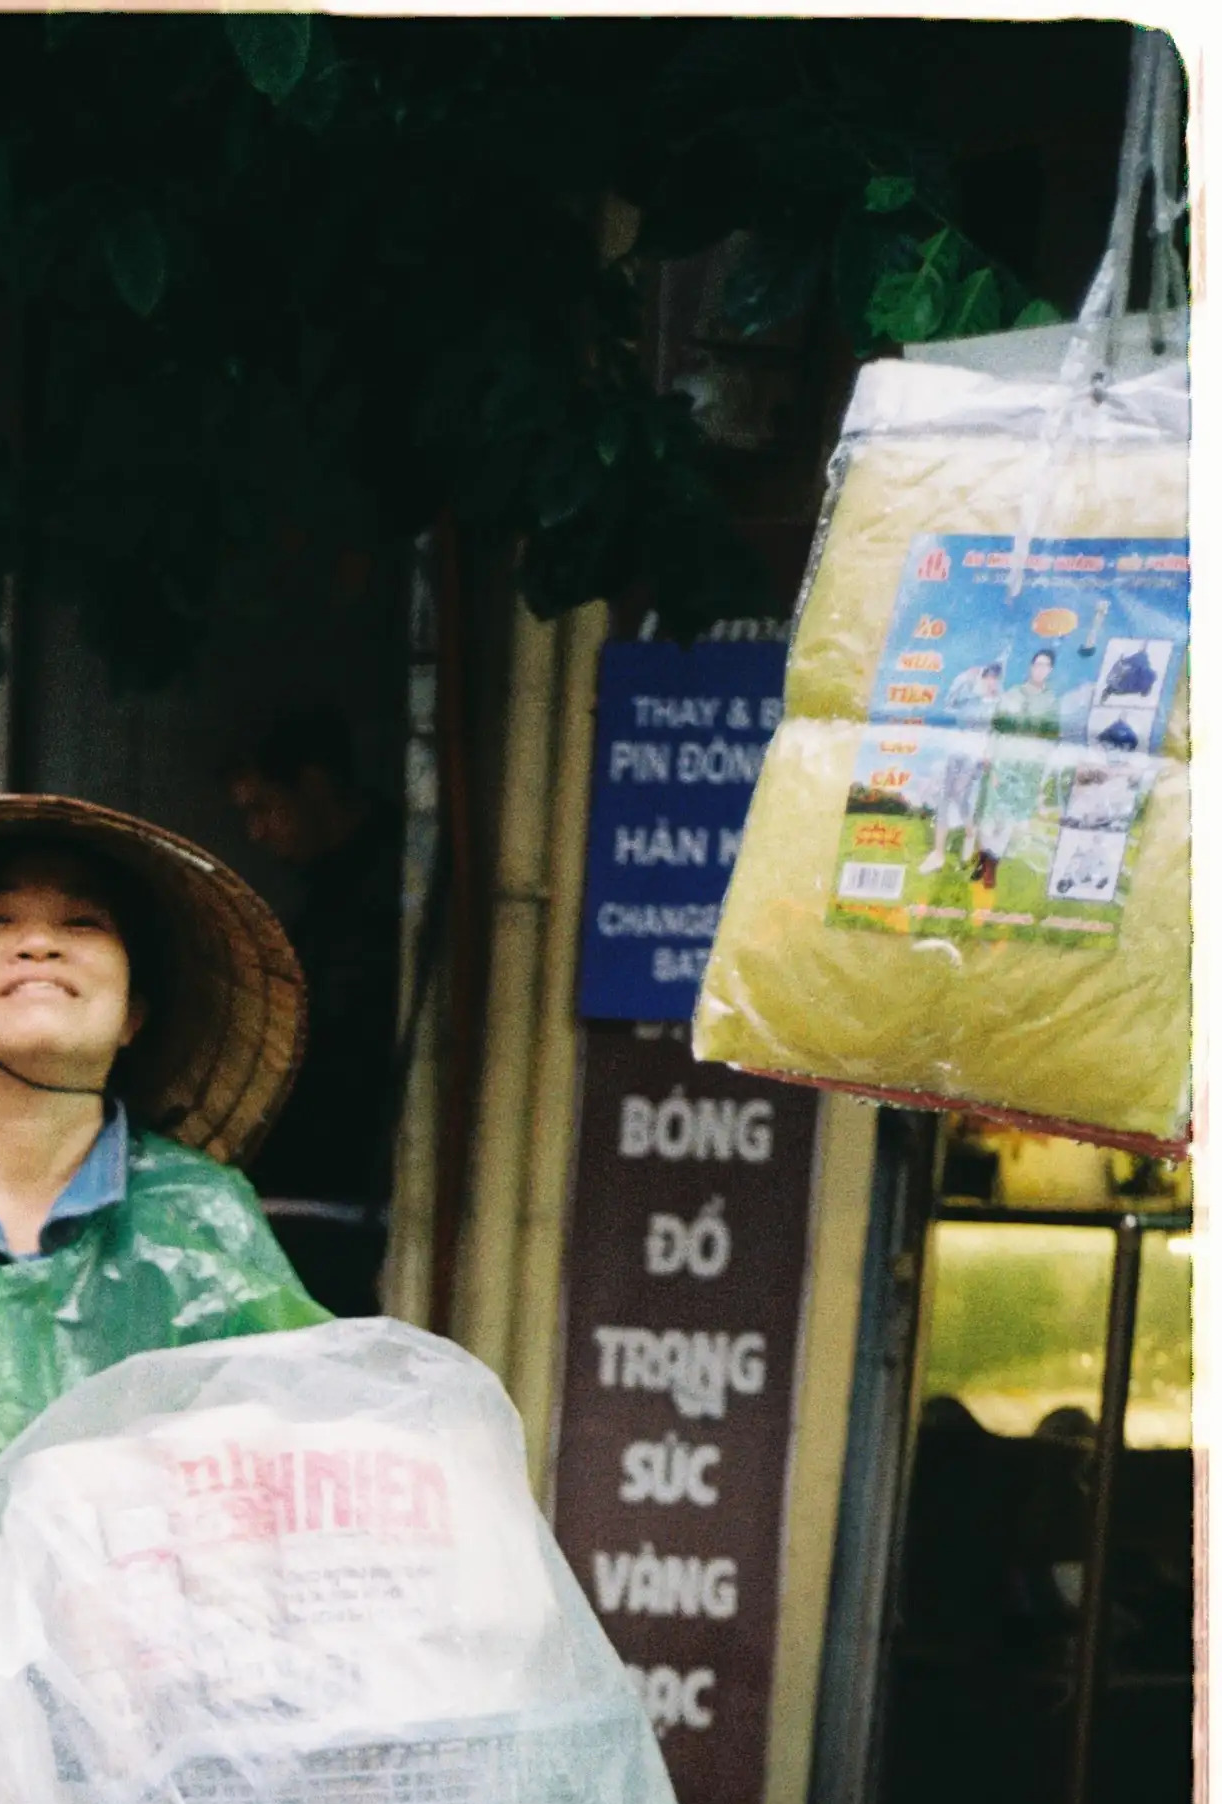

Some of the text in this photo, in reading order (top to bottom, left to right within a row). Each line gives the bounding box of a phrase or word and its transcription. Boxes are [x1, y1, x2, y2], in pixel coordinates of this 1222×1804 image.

[631, 696, 722, 729] THAY
[726, 697, 752, 731] &
[609, 740, 671, 783] PIN
[618, 1083, 776, 1163] BÓNG
